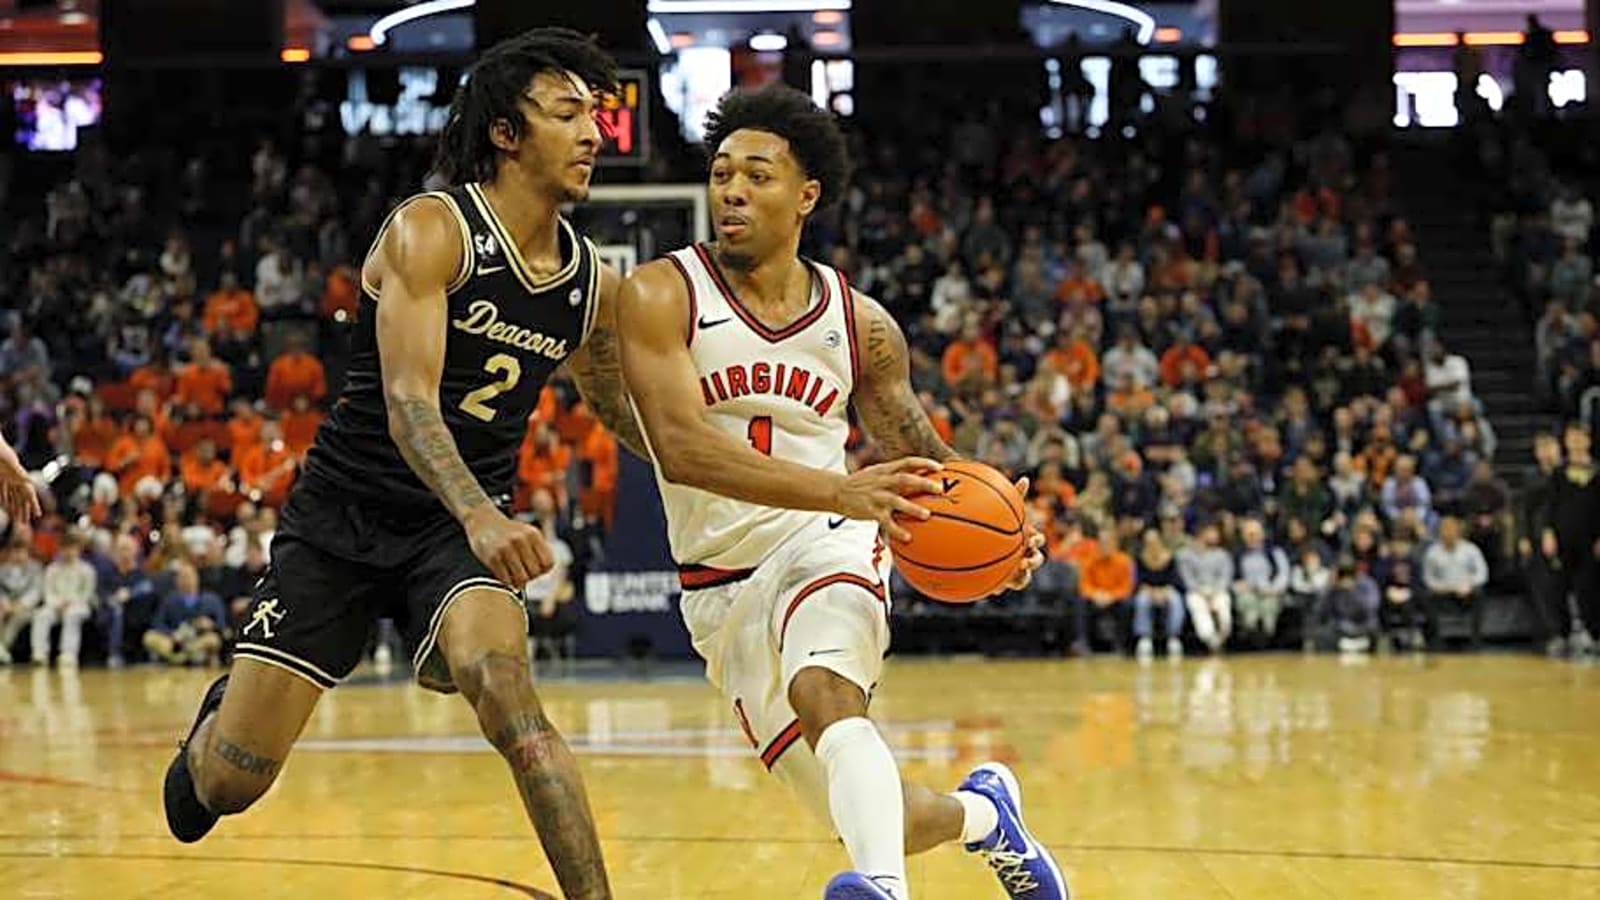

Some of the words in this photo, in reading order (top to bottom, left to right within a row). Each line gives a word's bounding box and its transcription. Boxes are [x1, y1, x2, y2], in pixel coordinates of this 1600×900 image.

[453, 300, 567, 360] Deacons
[458, 353, 522, 422] 2
[747, 415, 772, 456] 1
